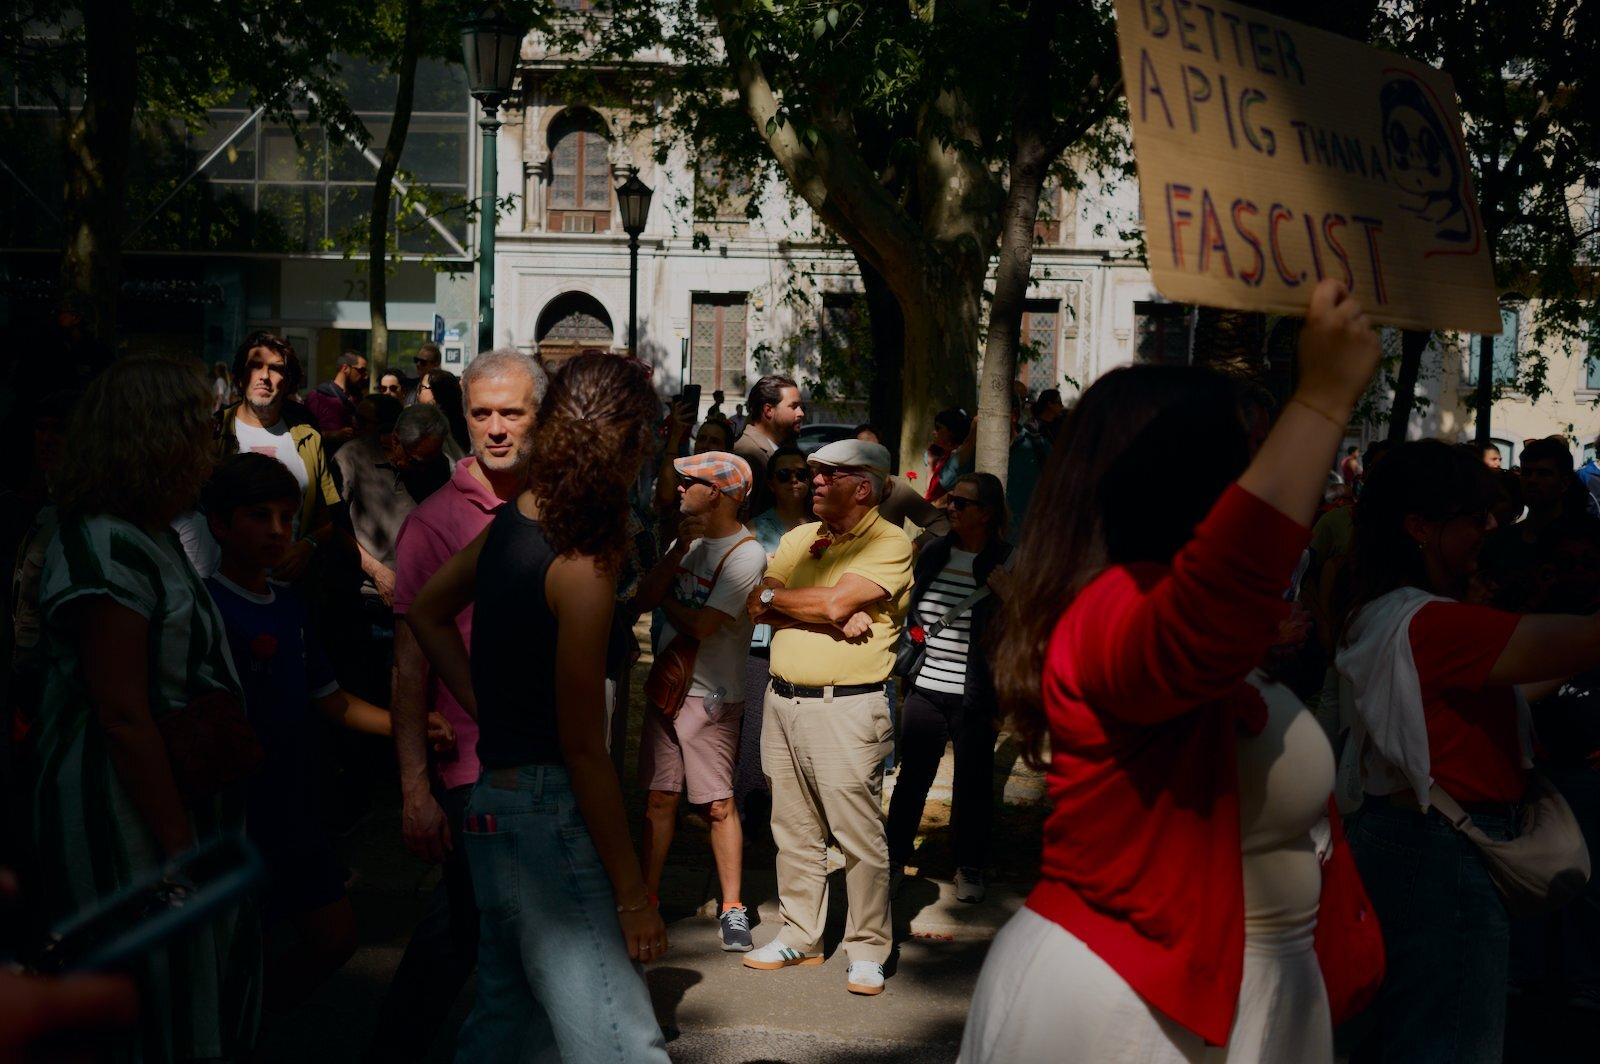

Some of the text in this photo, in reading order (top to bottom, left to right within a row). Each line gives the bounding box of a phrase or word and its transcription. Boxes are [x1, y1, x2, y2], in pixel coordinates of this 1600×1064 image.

[1140, 0, 1306, 86] BETTER
[1141, 48, 1174, 129] A
[1181, 65, 1277, 156] PIG
[1290, 120, 1367, 178] THAN
[343, 279, 367, 300] 23
[1166, 183, 1389, 305] FASCIST
